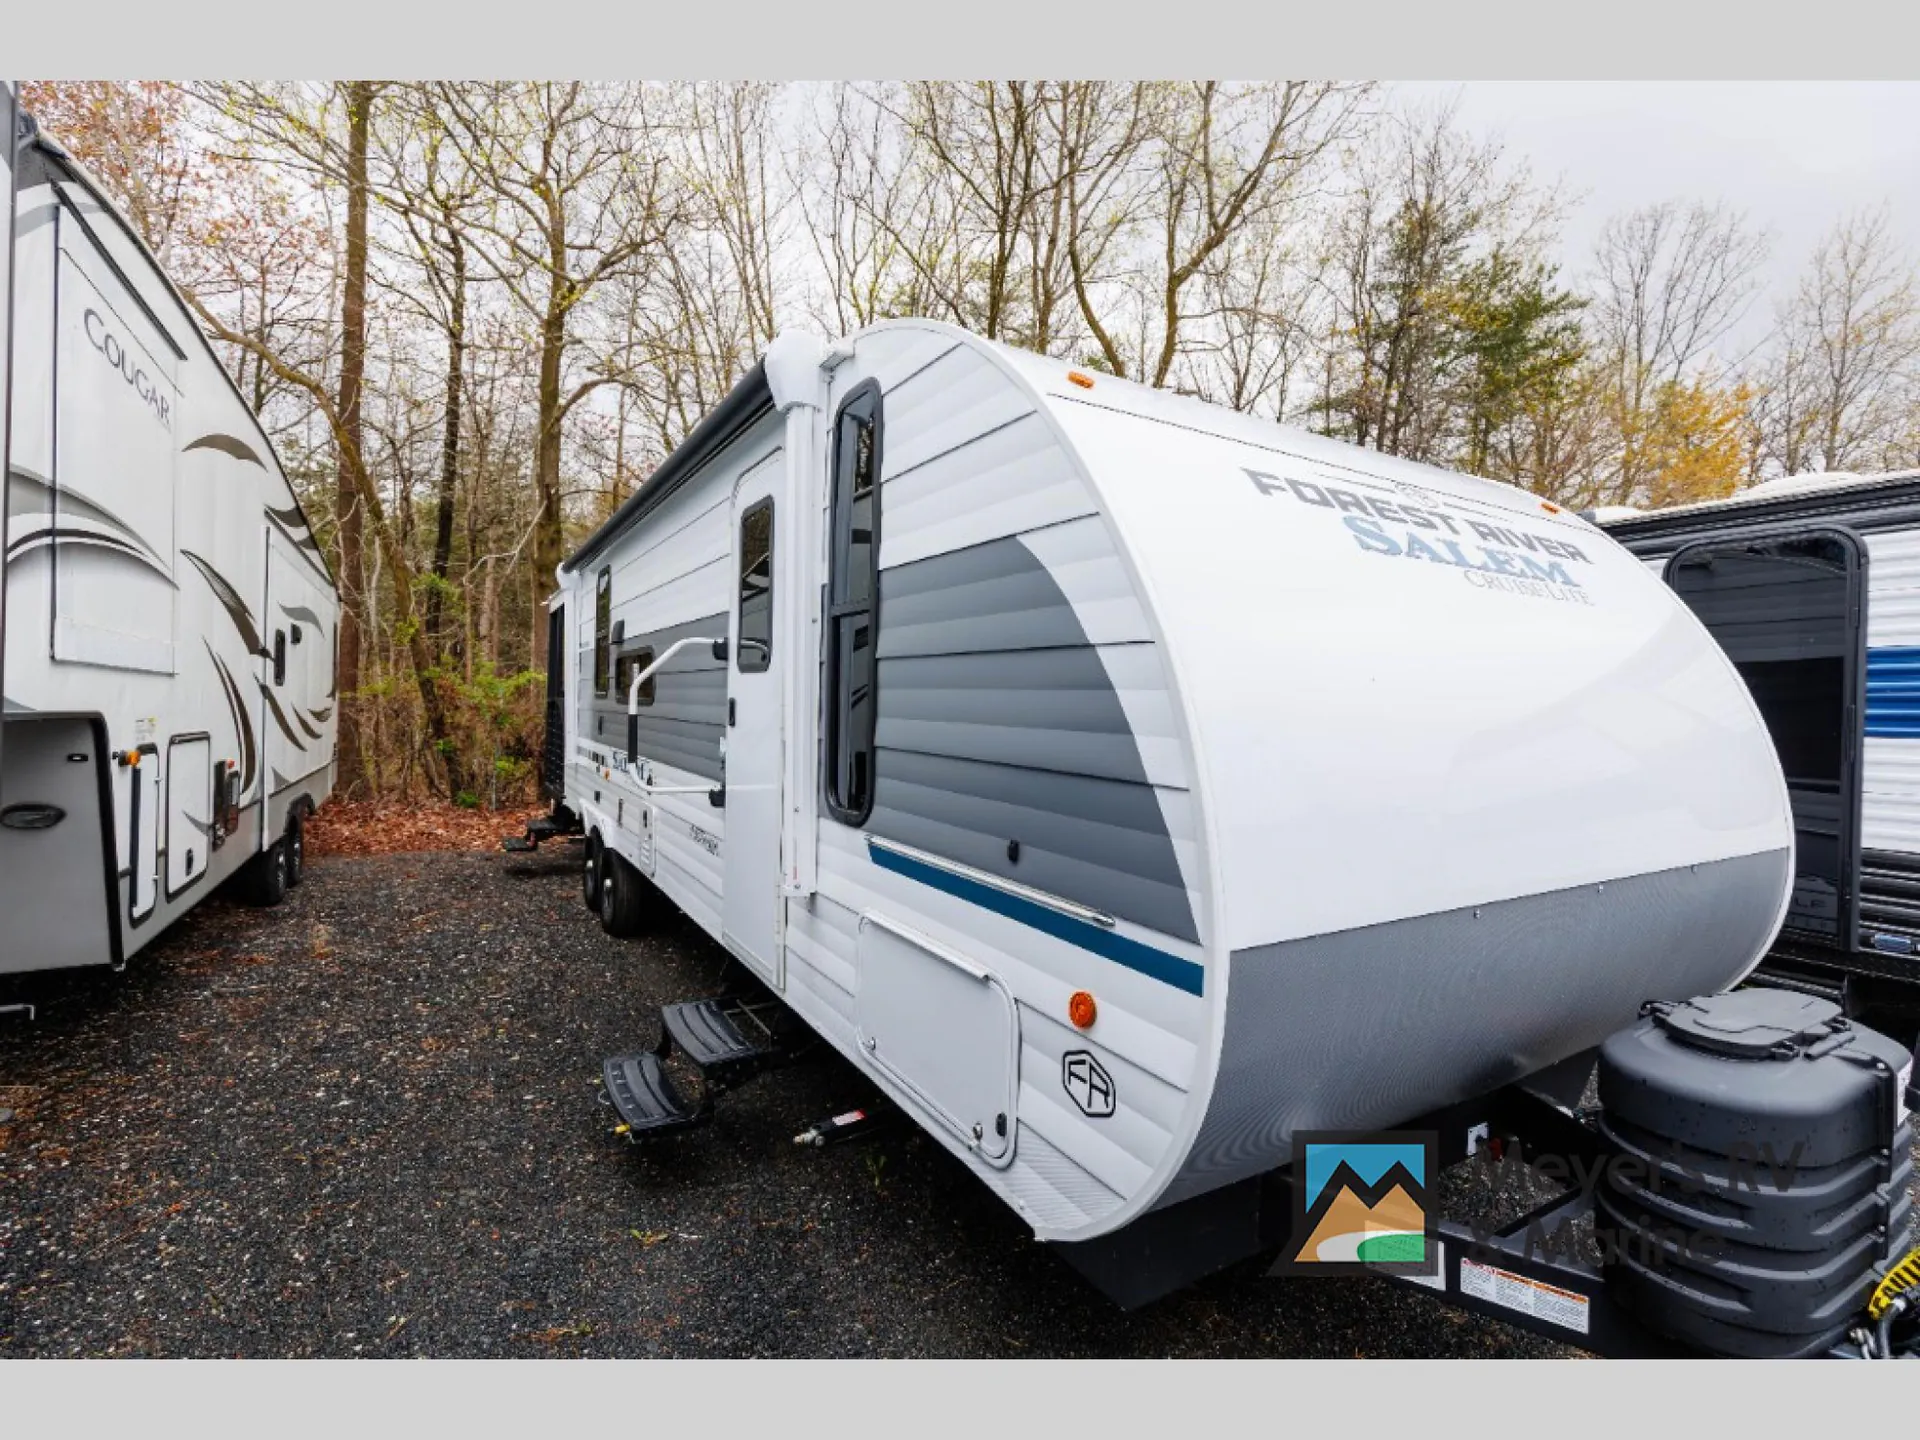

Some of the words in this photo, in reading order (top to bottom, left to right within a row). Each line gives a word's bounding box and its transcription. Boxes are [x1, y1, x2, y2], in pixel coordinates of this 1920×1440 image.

[84, 308, 171, 425] COUGAR
[1240, 466, 1461, 535] FOREST
[1465, 518, 1594, 564] RIVER
[1343, 515, 1581, 587] SALEM
